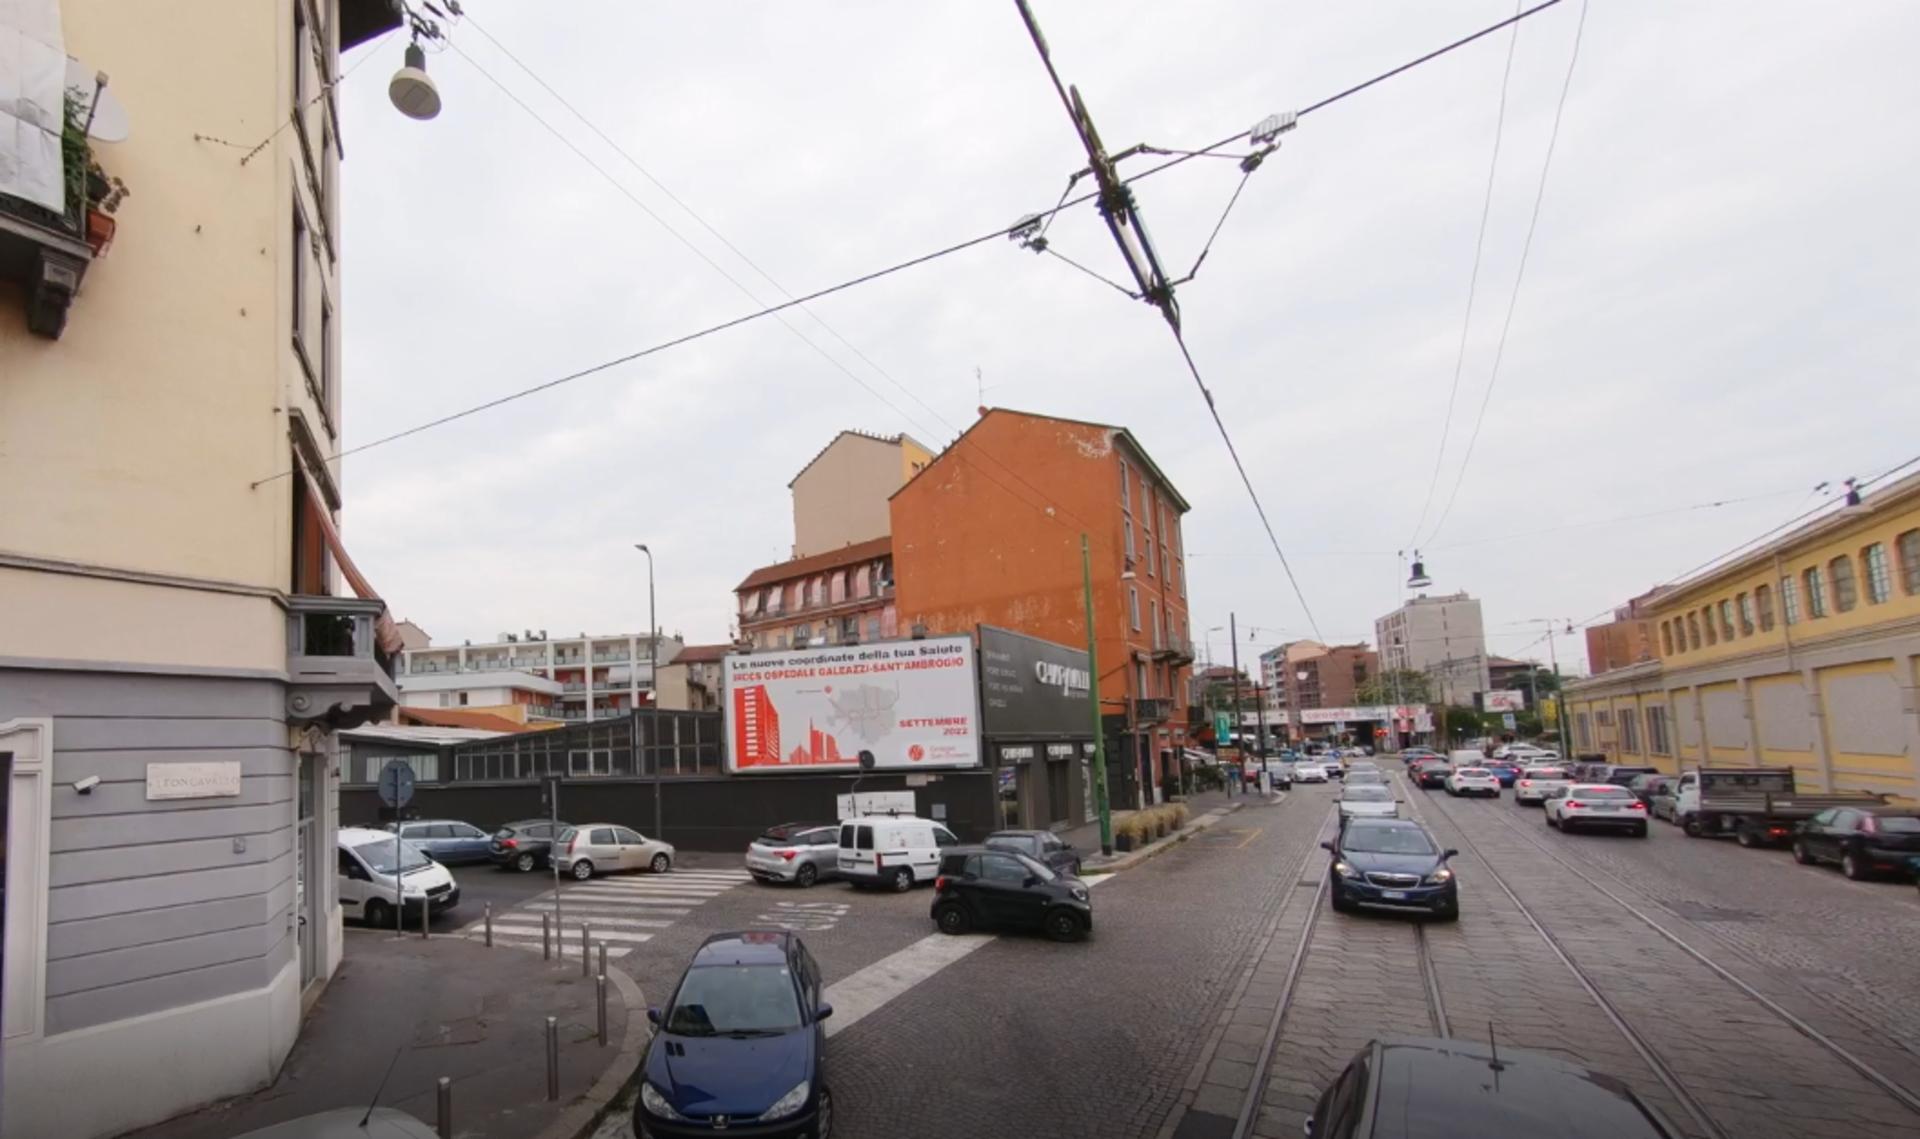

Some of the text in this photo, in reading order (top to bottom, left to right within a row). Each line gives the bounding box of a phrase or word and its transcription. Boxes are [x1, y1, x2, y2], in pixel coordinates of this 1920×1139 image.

[732, 644, 963, 670] Le nuove coordinate della tua Salute
[764, 667, 816, 680] OSPEDALE
[899, 717, 968, 728] SETTEMBRE
[943, 727, 968, 736] 2022
